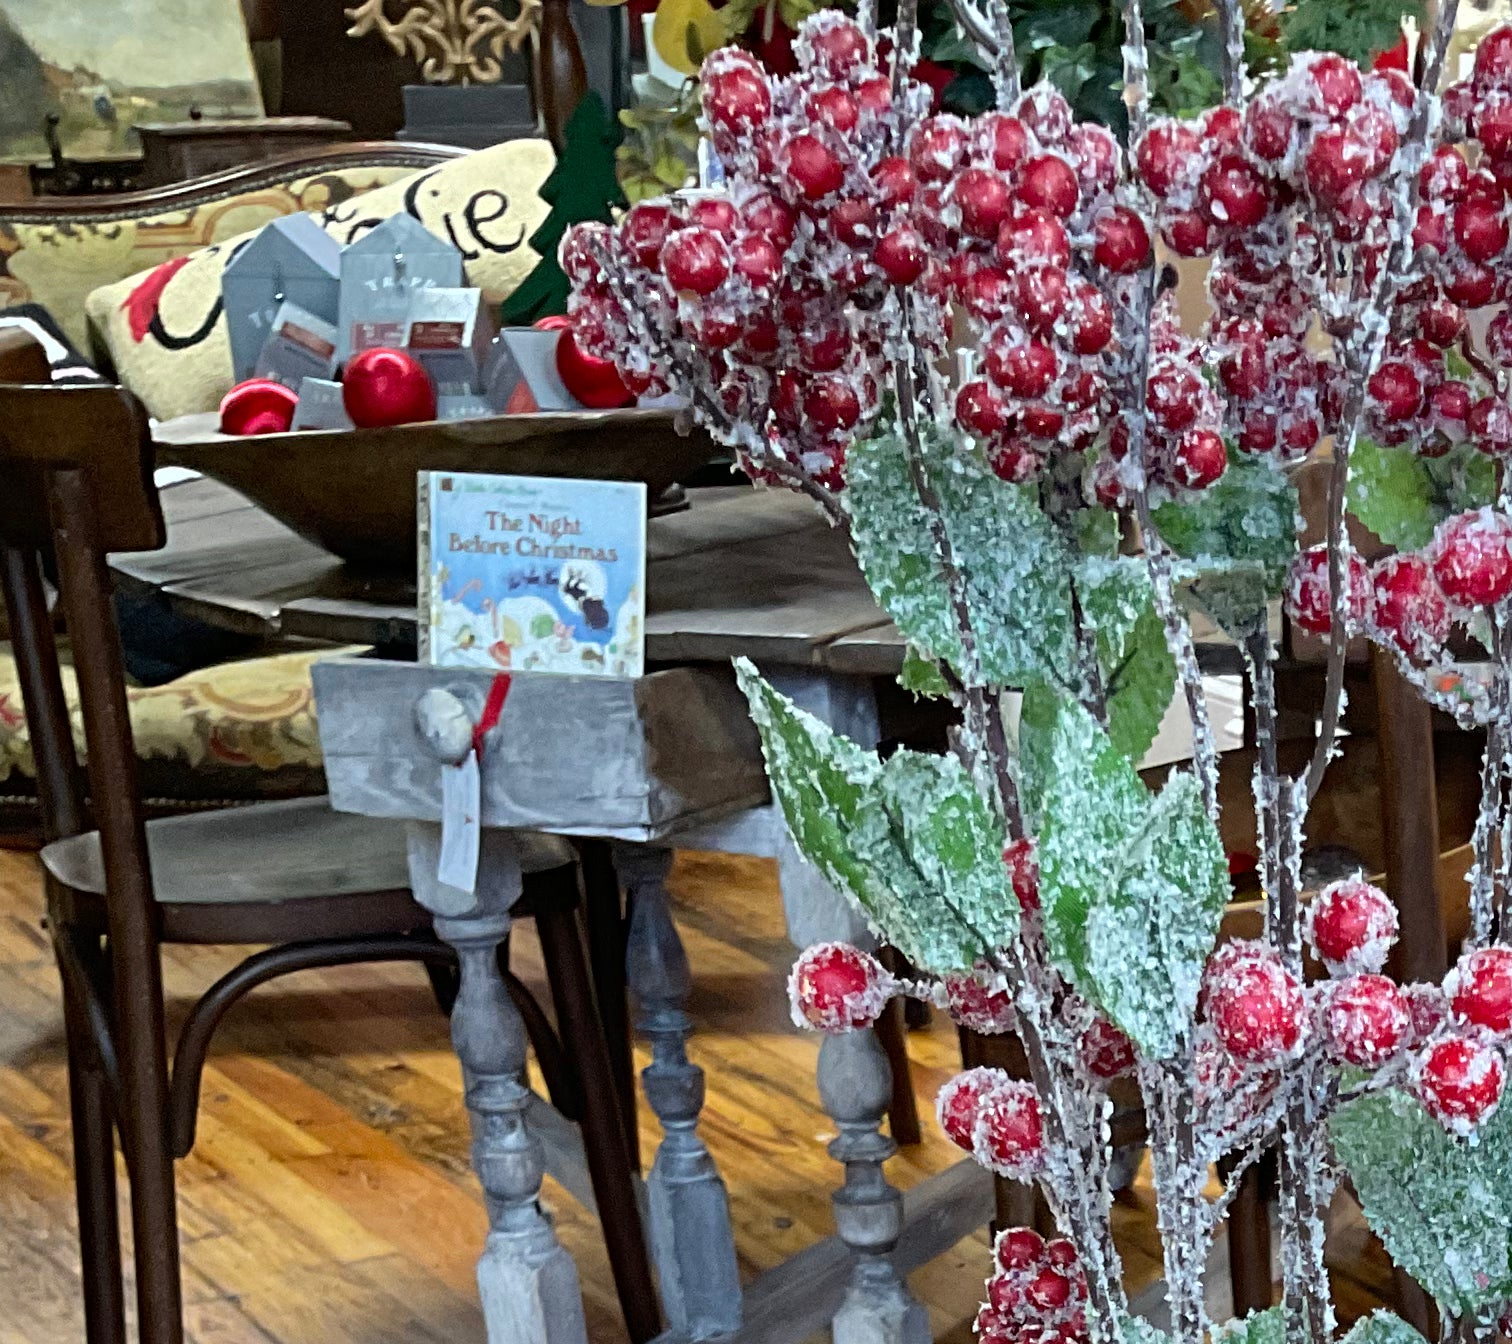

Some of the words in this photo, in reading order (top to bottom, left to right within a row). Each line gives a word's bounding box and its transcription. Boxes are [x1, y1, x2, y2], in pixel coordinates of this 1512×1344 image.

[485, 510, 523, 532] The
[528, 513, 583, 539] Night
[449, 532, 511, 556] Before
[515, 537, 618, 562] Christmas
